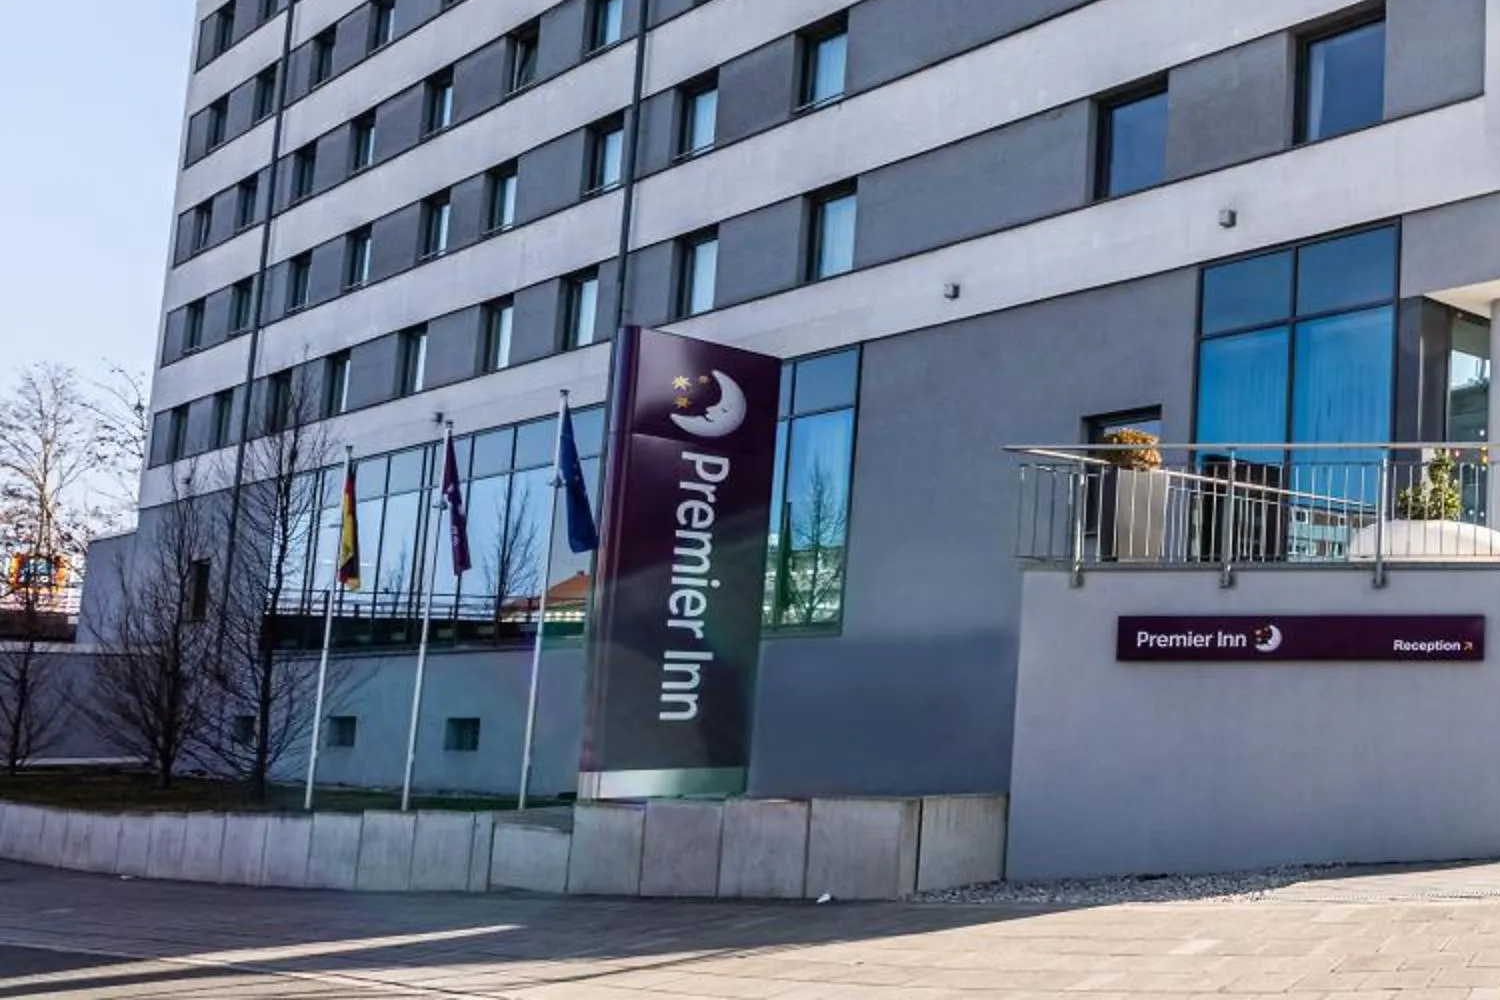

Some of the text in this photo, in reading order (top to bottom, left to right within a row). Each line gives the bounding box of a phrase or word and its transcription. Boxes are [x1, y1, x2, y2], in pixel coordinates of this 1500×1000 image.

[659, 451, 730, 721] Premier Inn
[1136, 631, 1247, 647] Premier Inn
[1393, 639, 1461, 653] Reception
